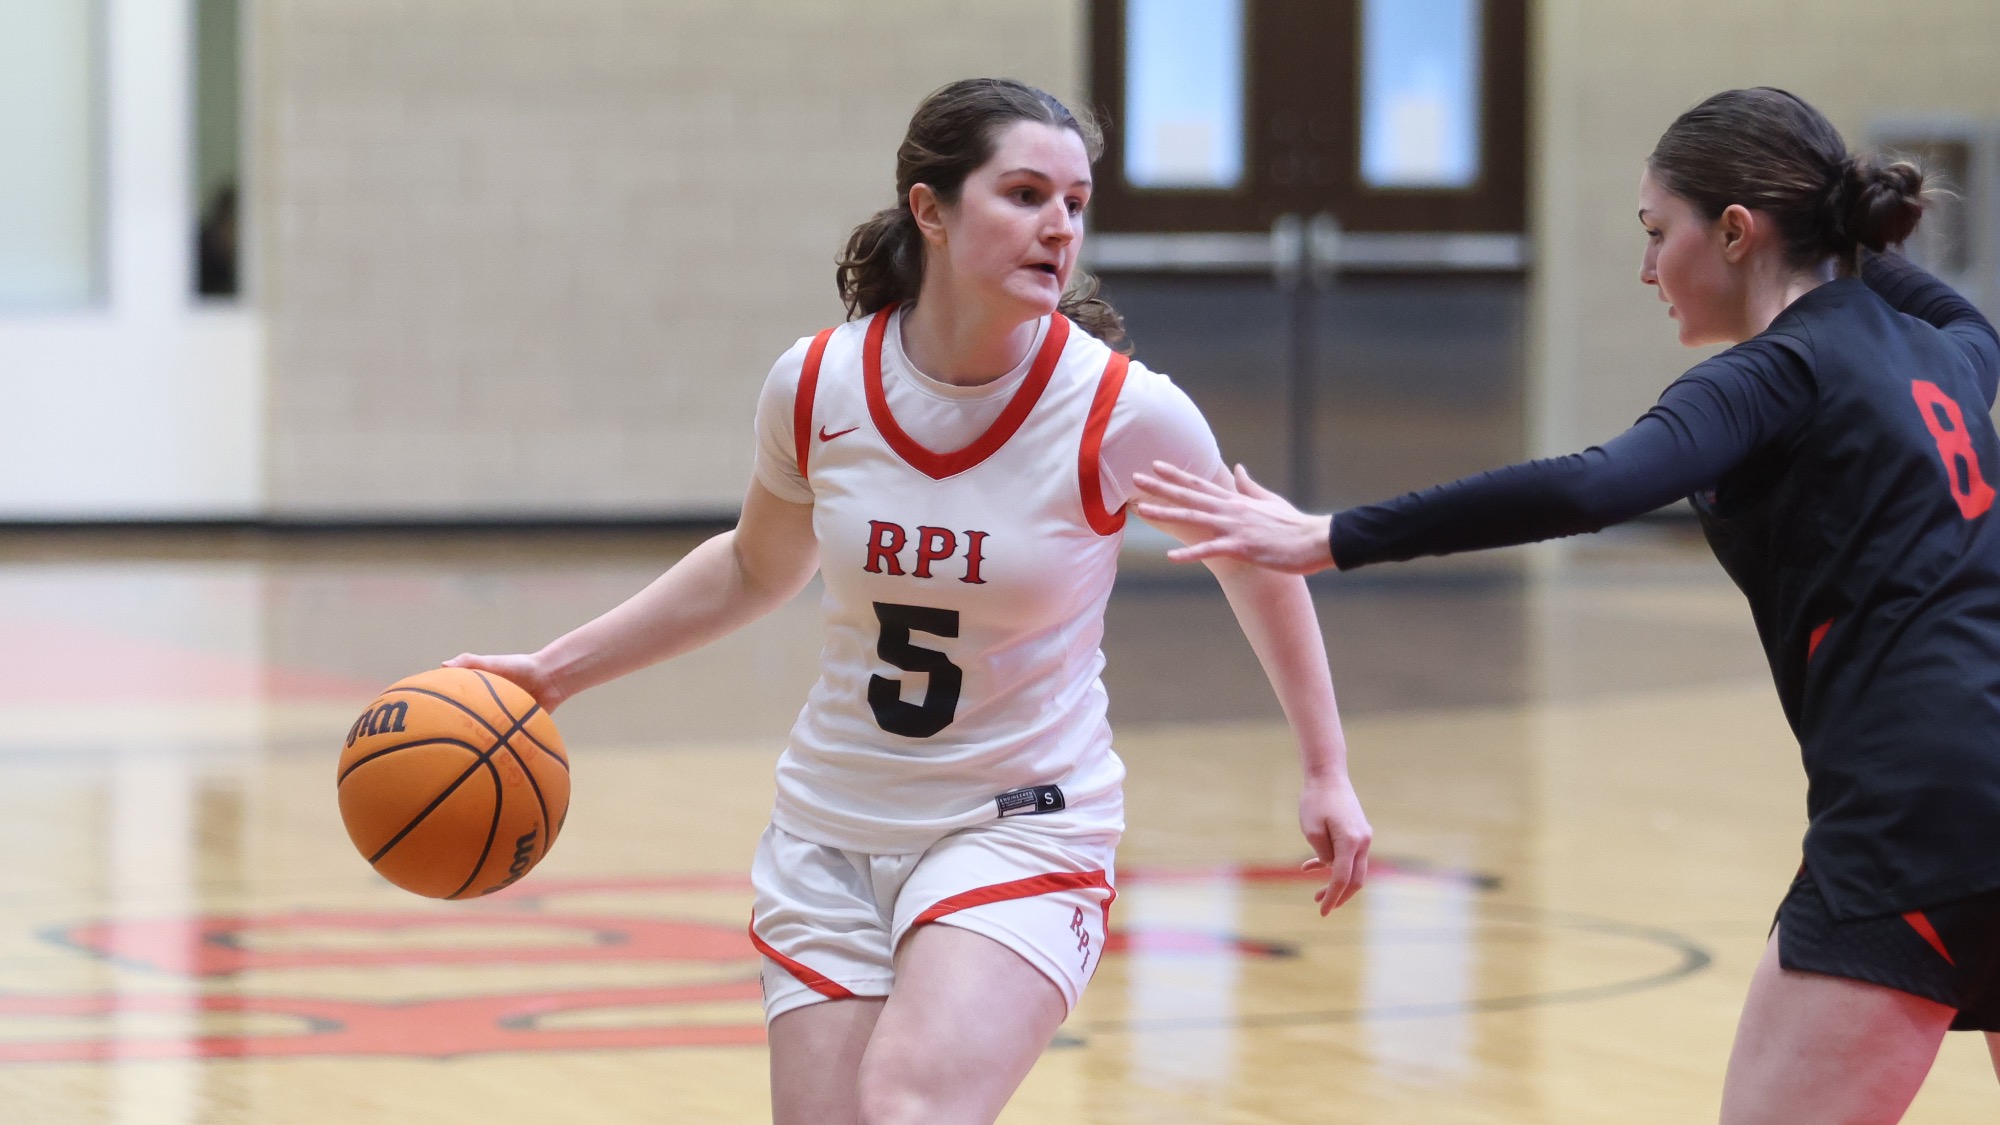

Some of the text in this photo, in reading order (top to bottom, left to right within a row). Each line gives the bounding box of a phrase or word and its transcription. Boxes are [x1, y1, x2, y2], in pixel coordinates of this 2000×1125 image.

[1911, 379, 1997, 520] 8
[863, 520, 990, 585] RPI
[867, 601, 963, 739] 5
[1044, 792, 1054, 805] S
[1070, 906, 1091, 974] RPI
